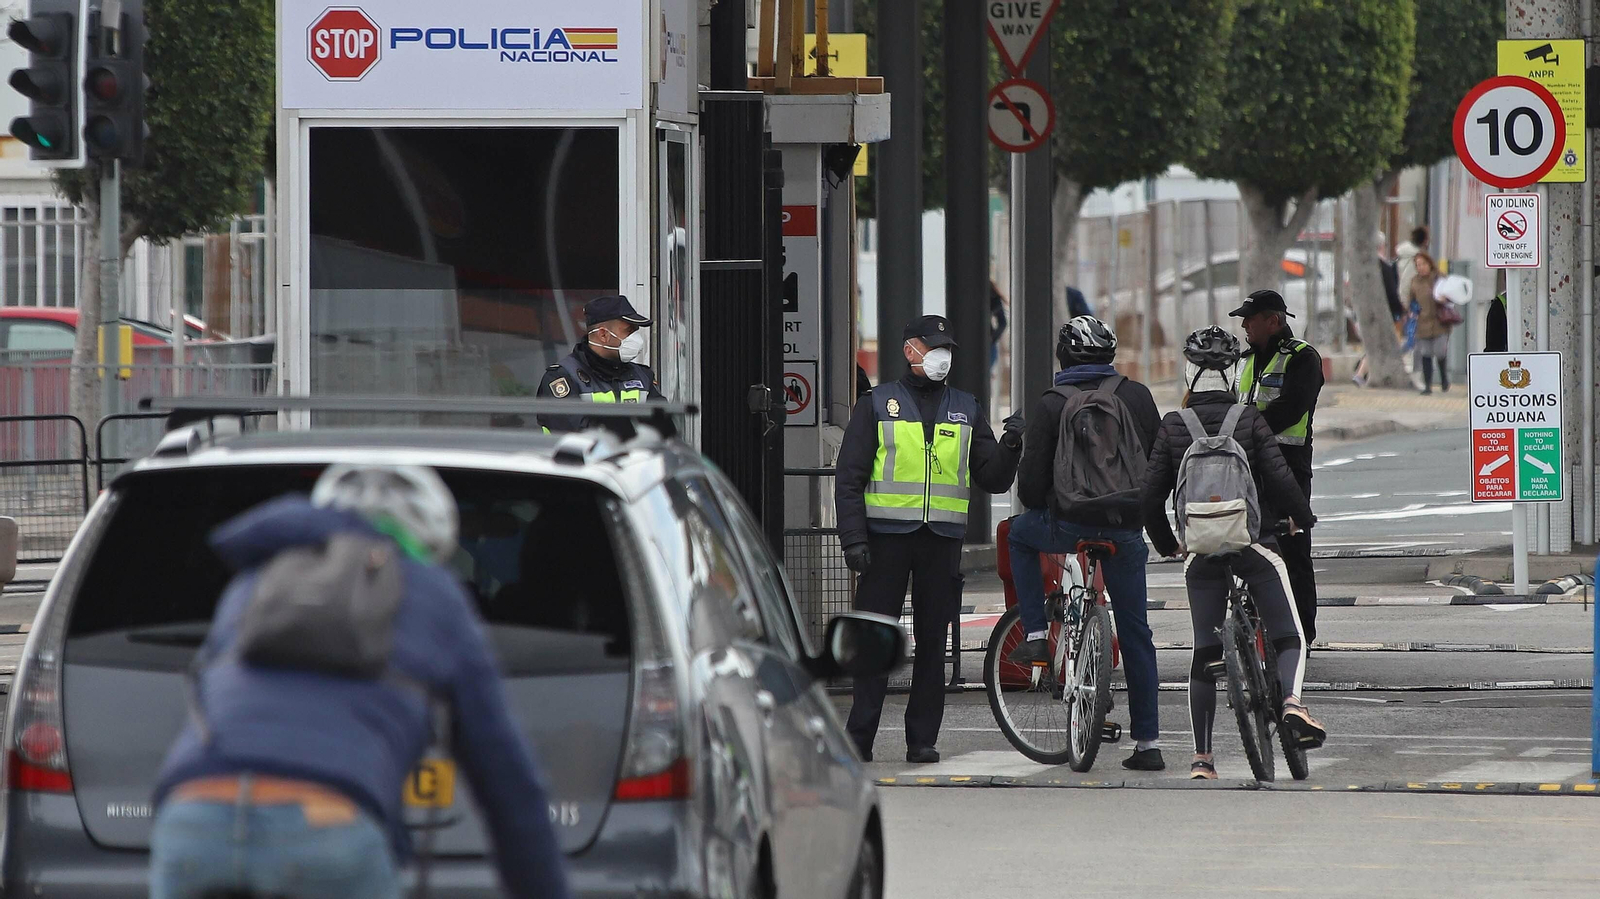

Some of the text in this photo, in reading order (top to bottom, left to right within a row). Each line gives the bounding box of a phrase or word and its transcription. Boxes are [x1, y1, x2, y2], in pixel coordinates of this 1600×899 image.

[990, 2, 1042, 18] GIVE
[1002, 24, 1034, 35] WAY
[315, 28, 374, 59] STOP
[500, 51, 618, 62] NACIONAL
[1528, 70, 1554, 78] ANPR
[1476, 106, 1543, 156] 10
[1491, 199, 1534, 208] NO IDLING
[1474, 394, 1557, 407] CUSTOMS
[1486, 411, 1546, 423] ADUANA
[1479, 477, 1510, 485] OBJETOS
[1477, 490, 1512, 498] DECLARAR
